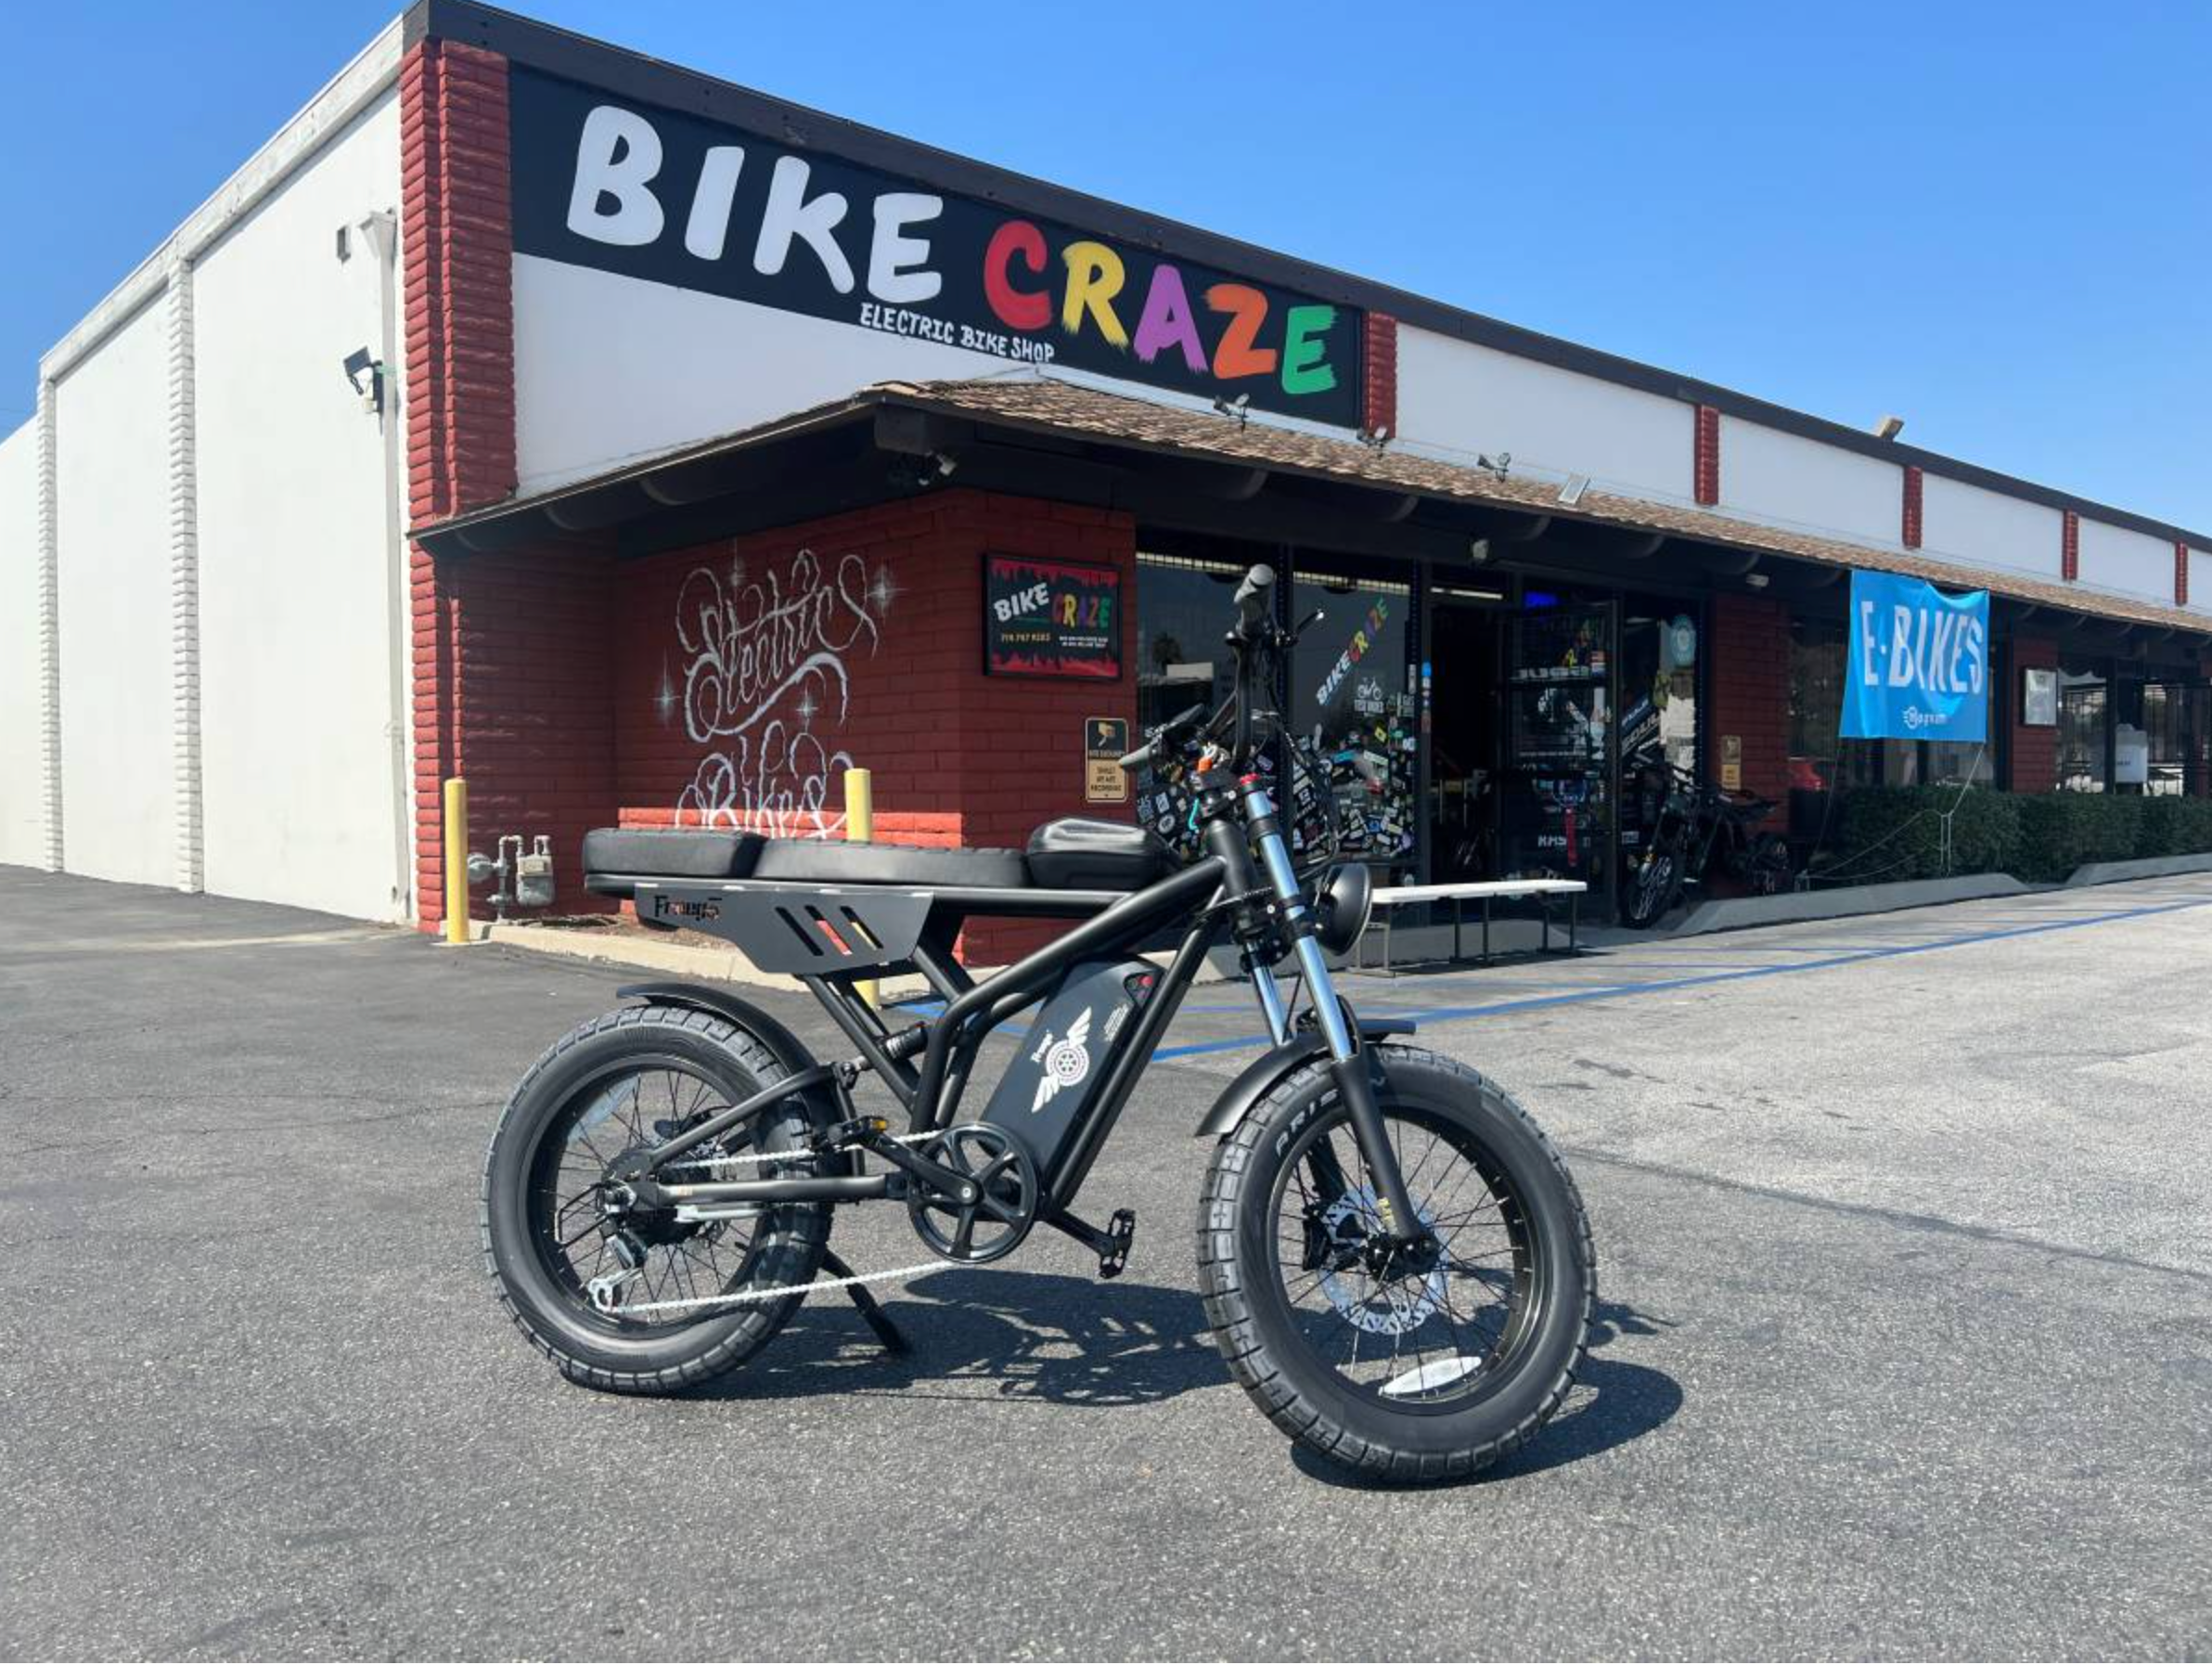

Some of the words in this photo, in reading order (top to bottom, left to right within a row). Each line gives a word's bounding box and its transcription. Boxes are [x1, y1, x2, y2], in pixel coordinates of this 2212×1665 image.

[566, 105, 944, 303] BIKE
[984, 220, 1340, 394] CRAZE
[860, 302, 954, 344] ELECTRIC
[959, 324, 1007, 357] BIKE
[1010, 337, 1055, 363] SHOP
[994, 582, 1049, 623] BIKE
[1052, 594, 1112, 628] CRAZE
[1316, 650, 1352, 705] BIKE
[1349, 597, 1389, 662] CRAZE
